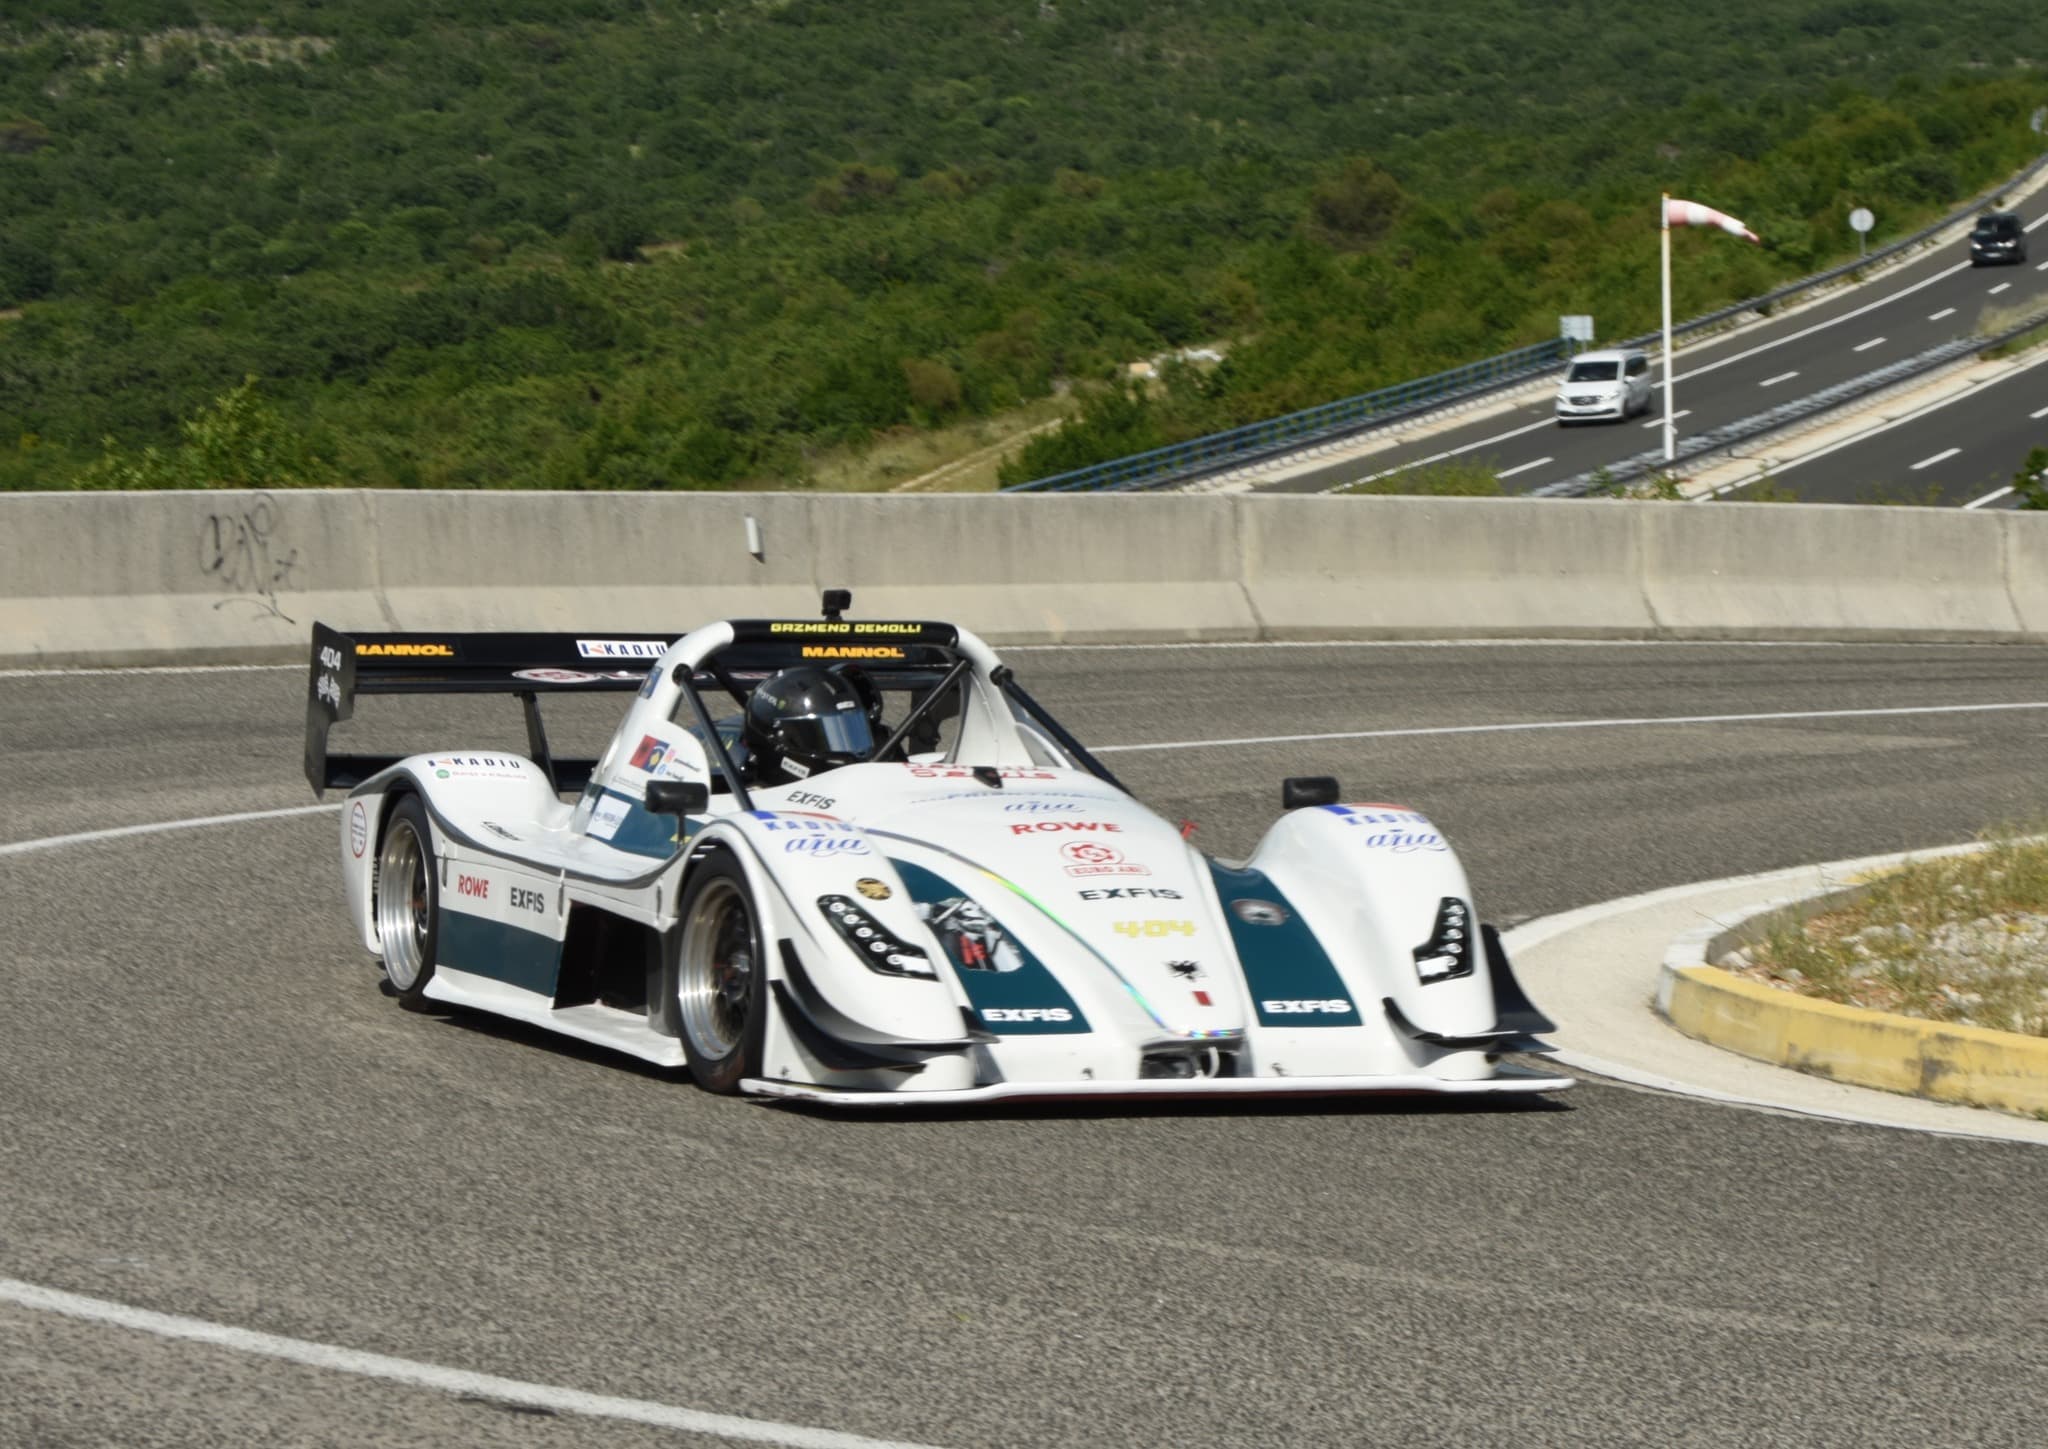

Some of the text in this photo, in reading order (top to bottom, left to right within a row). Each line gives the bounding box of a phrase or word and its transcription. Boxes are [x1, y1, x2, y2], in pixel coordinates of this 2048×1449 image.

[854, 623, 921, 633] DEMOLLI
[320, 646, 342, 671] 404
[802, 646, 905, 658] MANNOL
[452, 758, 520, 769] KADIU
[786, 790, 836, 810] EXFIS
[1010, 822, 1123, 835] ROWE
[457, 874, 489, 900] ROWE
[510, 886, 545, 915] EXFIS
[1078, 888, 1183, 901] EXFIS
[1113, 920, 1197, 937] 404
[1262, 999, 1352, 1014] EXFIS
[981, 1008, 1072, 1022] EXFIS
